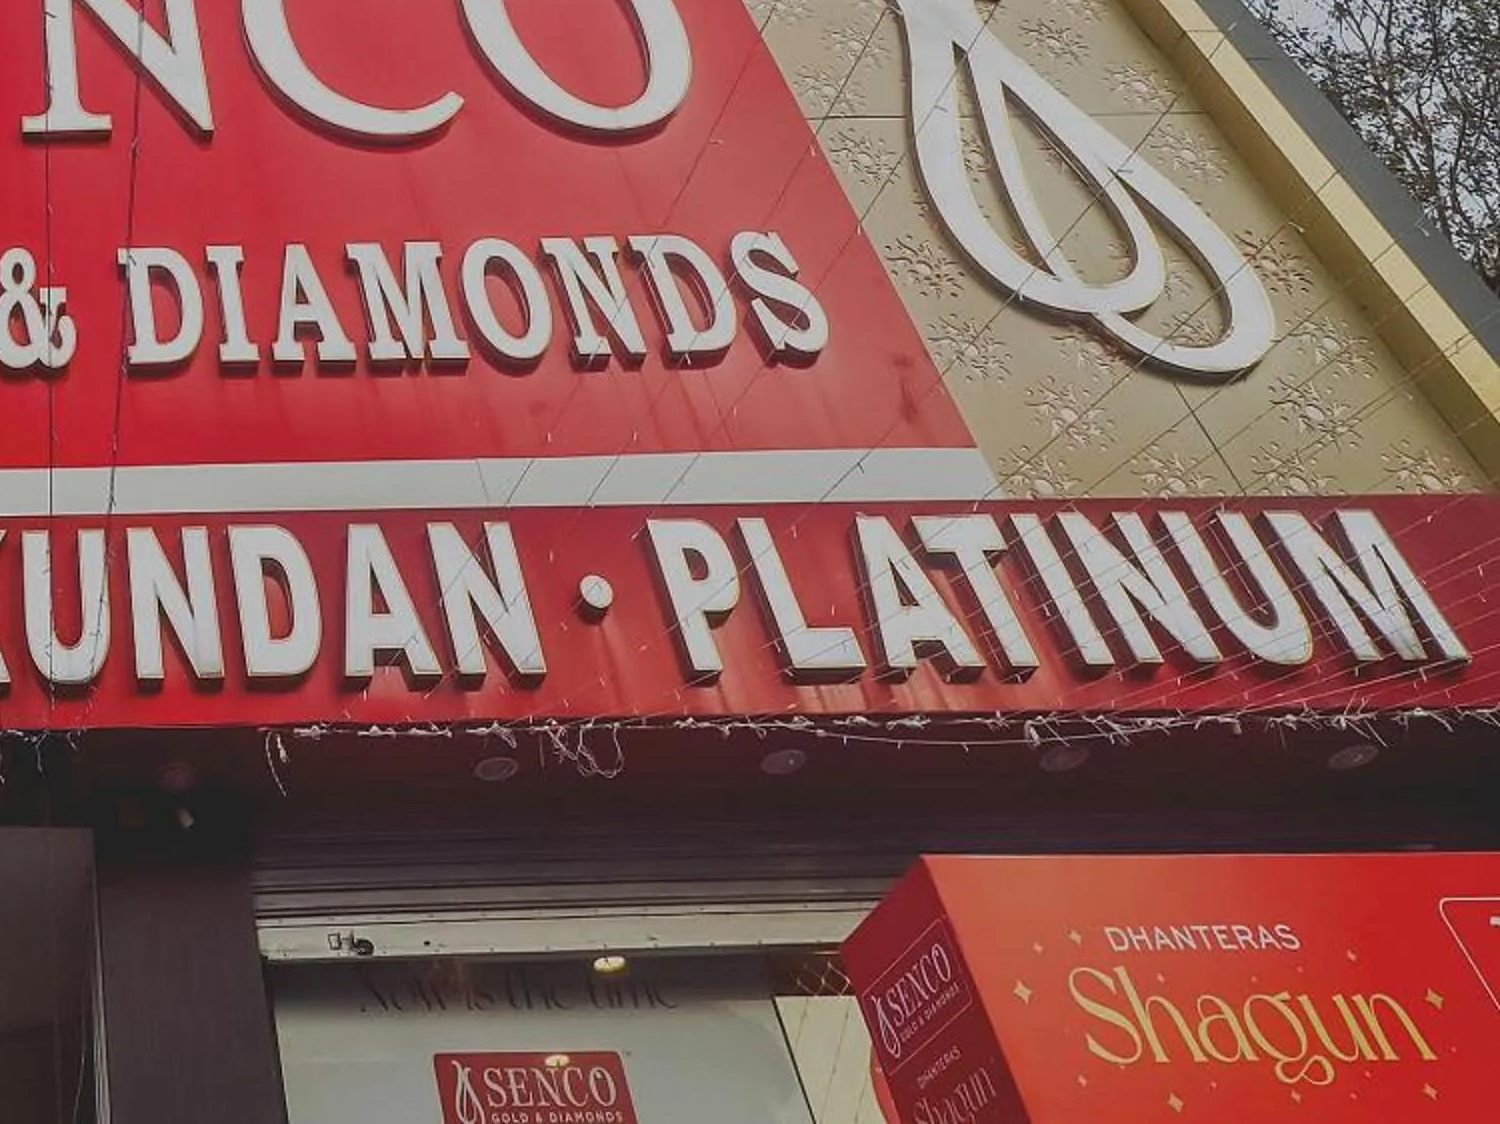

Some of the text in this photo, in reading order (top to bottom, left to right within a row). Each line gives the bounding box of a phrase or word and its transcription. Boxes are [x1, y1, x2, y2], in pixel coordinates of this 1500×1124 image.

[116, 230, 832, 369] DIAMONDS
[645, 508, 1471, 685] PLATINUM
[1103, 924, 1301, 952] DHANTERAS
[885, 943, 951, 1027] SENCO
[1068, 965, 1438, 1086] Shagun
[482, 1066, 618, 1108] SENCO
[491, 1112, 529, 1124] GOLD
[549, 1111, 623, 1124] DIAMONDS
